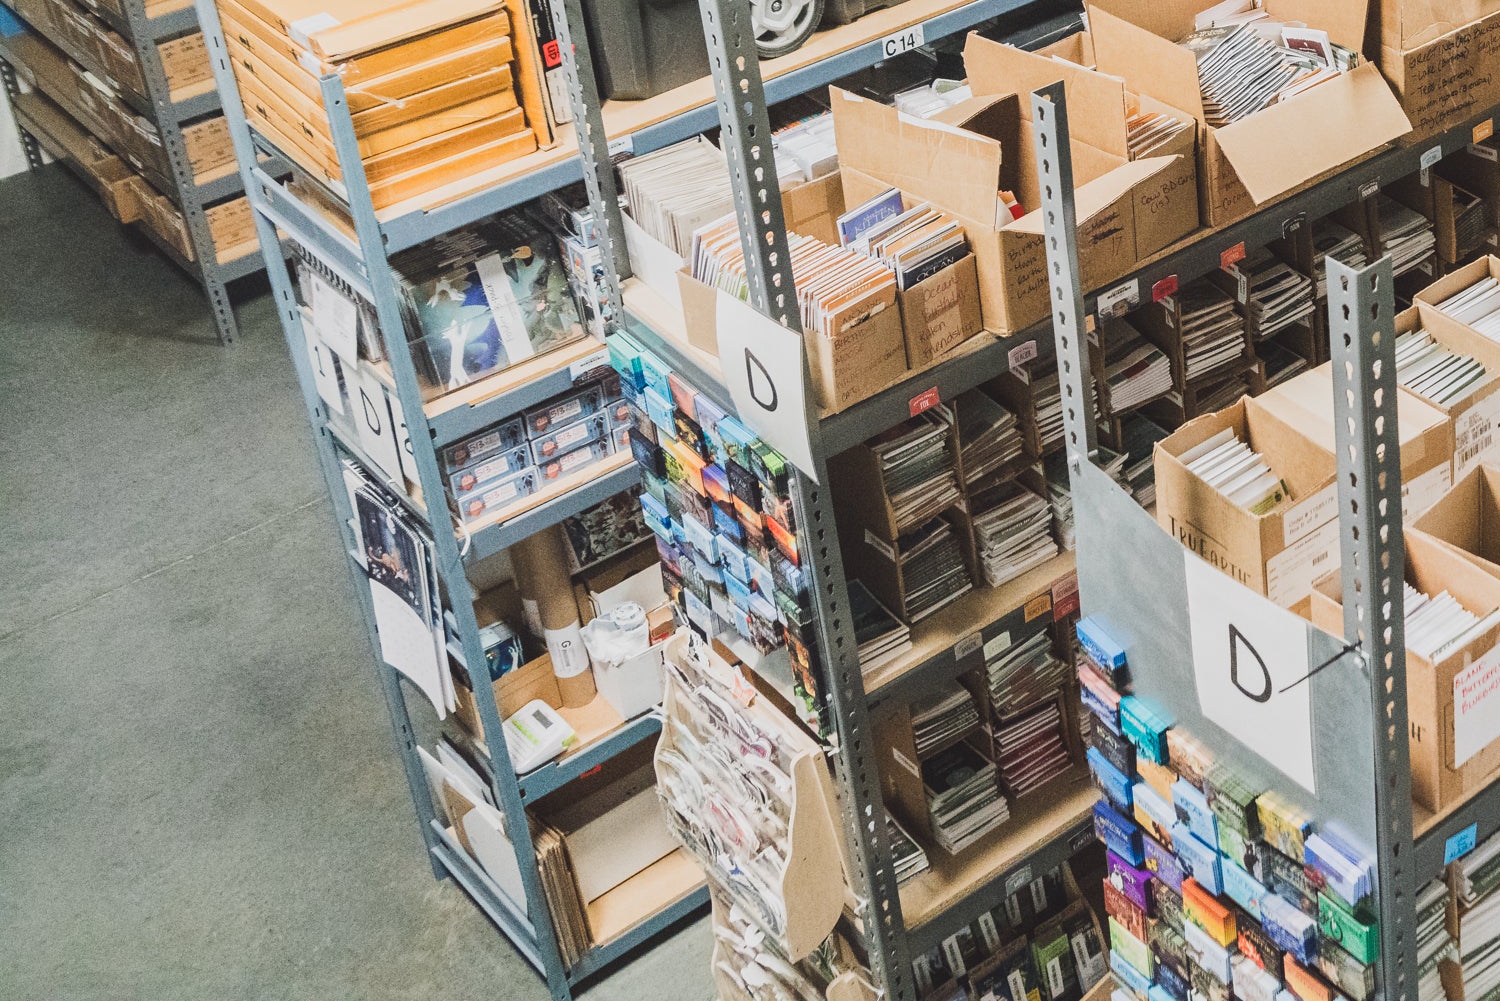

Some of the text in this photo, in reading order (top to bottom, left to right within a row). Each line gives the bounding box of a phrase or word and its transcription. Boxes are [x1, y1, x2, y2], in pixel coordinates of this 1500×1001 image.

[885, 33, 915, 57] C 14
[854, 206, 897, 235] KITTEN
[916, 257, 954, 282] OCEAN
[744, 346, 779, 412] D
[359, 386, 381, 437] D
[561, 639, 571, 651] G
[1229, 623, 1273, 704] D
